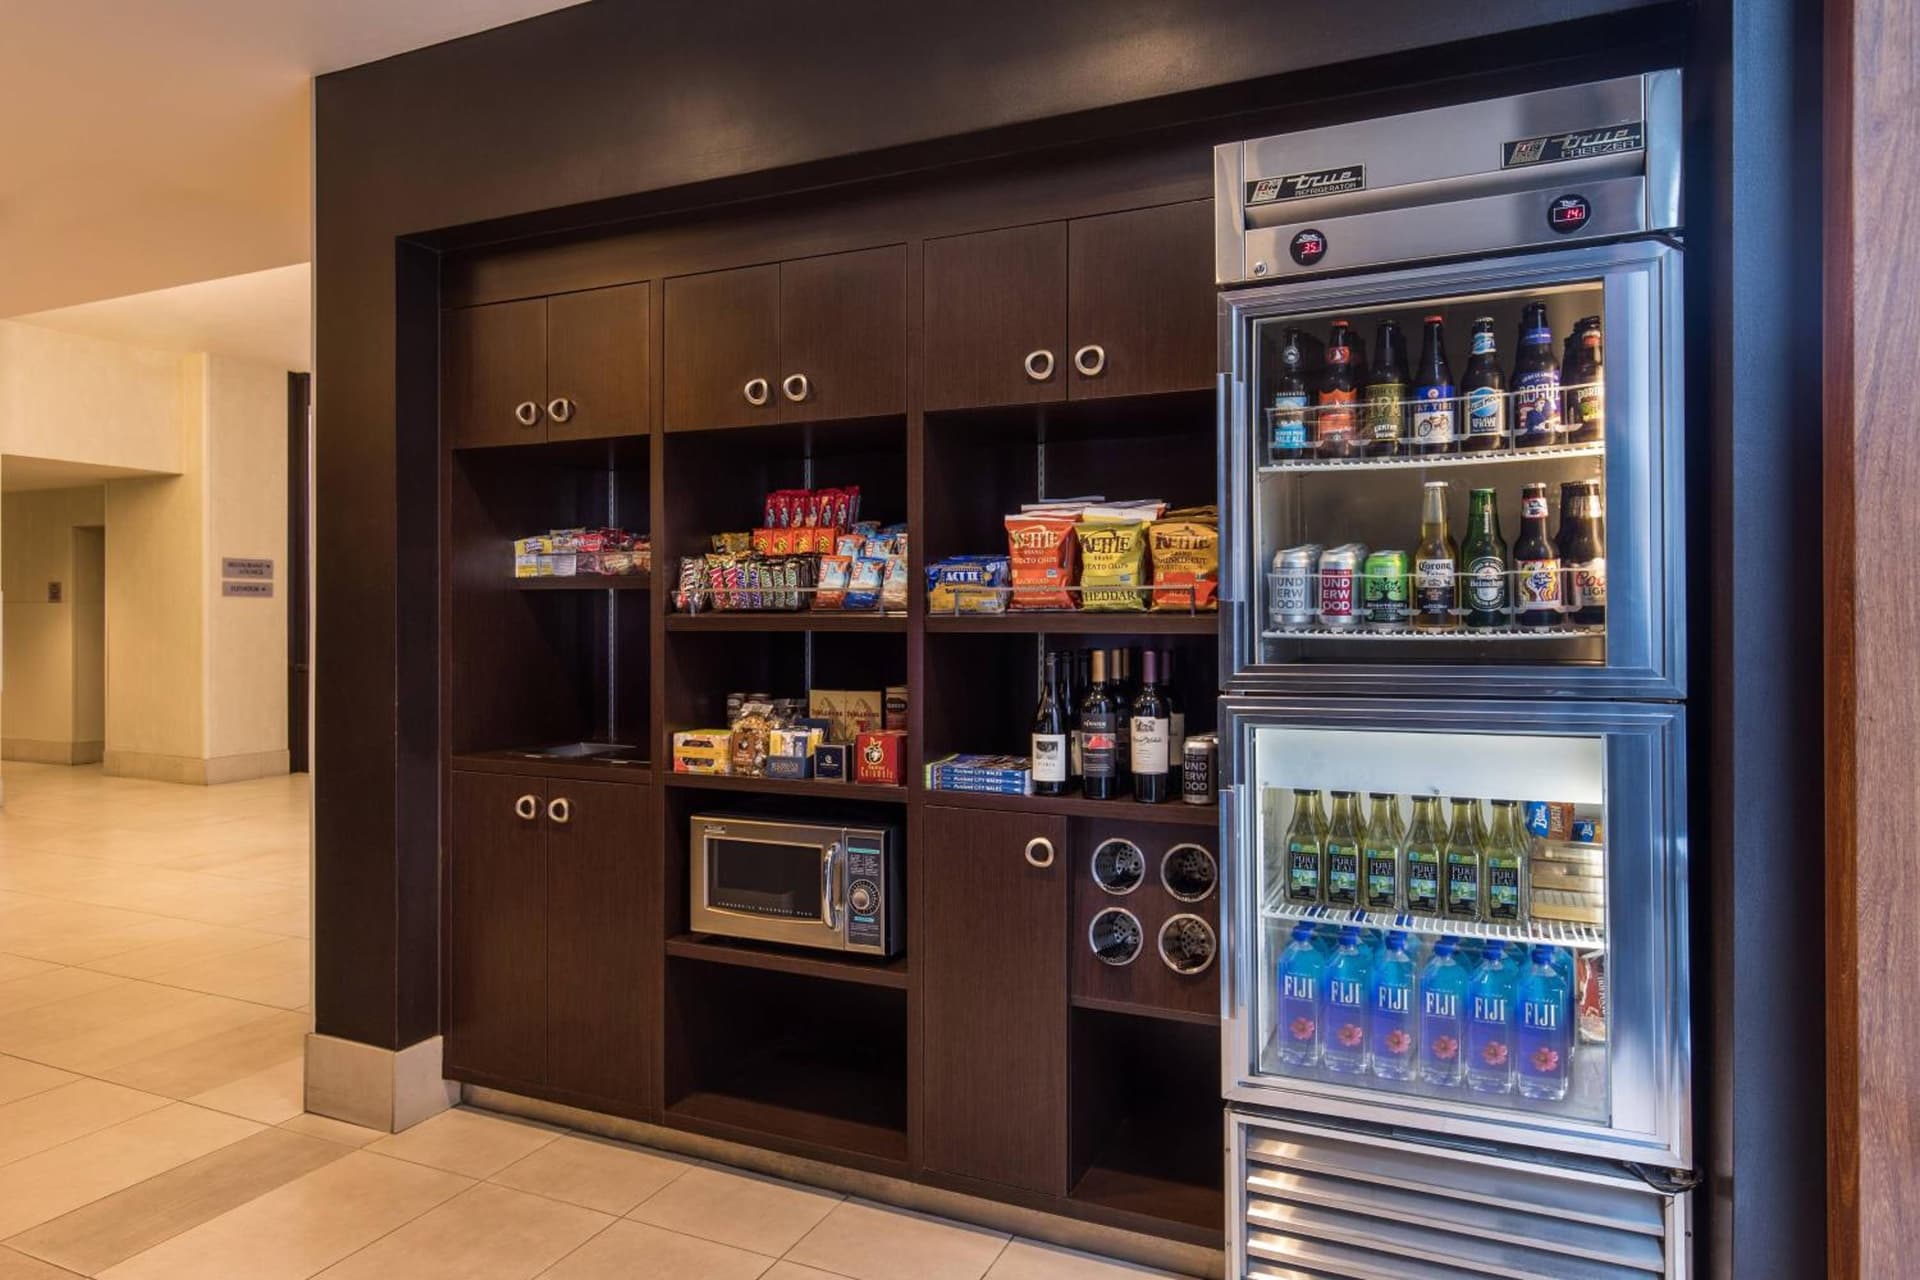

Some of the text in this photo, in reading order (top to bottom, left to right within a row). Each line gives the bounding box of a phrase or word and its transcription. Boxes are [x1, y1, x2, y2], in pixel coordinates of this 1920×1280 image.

[1010, 525, 1060, 548] KETTLE
[1277, 577, 1304, 587] UND
[1323, 578, 1351, 588] UND
[1278, 588, 1304, 598] ERW
[1323, 590, 1351, 599] ERW
[1277, 600, 1304, 609] OOD
[1323, 601, 1351, 611] OOD
[1184, 761, 1207, 771] UND
[1185, 772, 1207, 781] ERW
[1184, 782, 1208, 791] OOD
[1284, 975, 1314, 999] FIJI
[1331, 981, 1361, 1004] FIJI
[1379, 987, 1409, 1011] FIJI
[1426, 991, 1457, 1017] FIJI
[1475, 996, 1505, 1021] FIJI
[1524, 1001, 1556, 1027] FIJI
